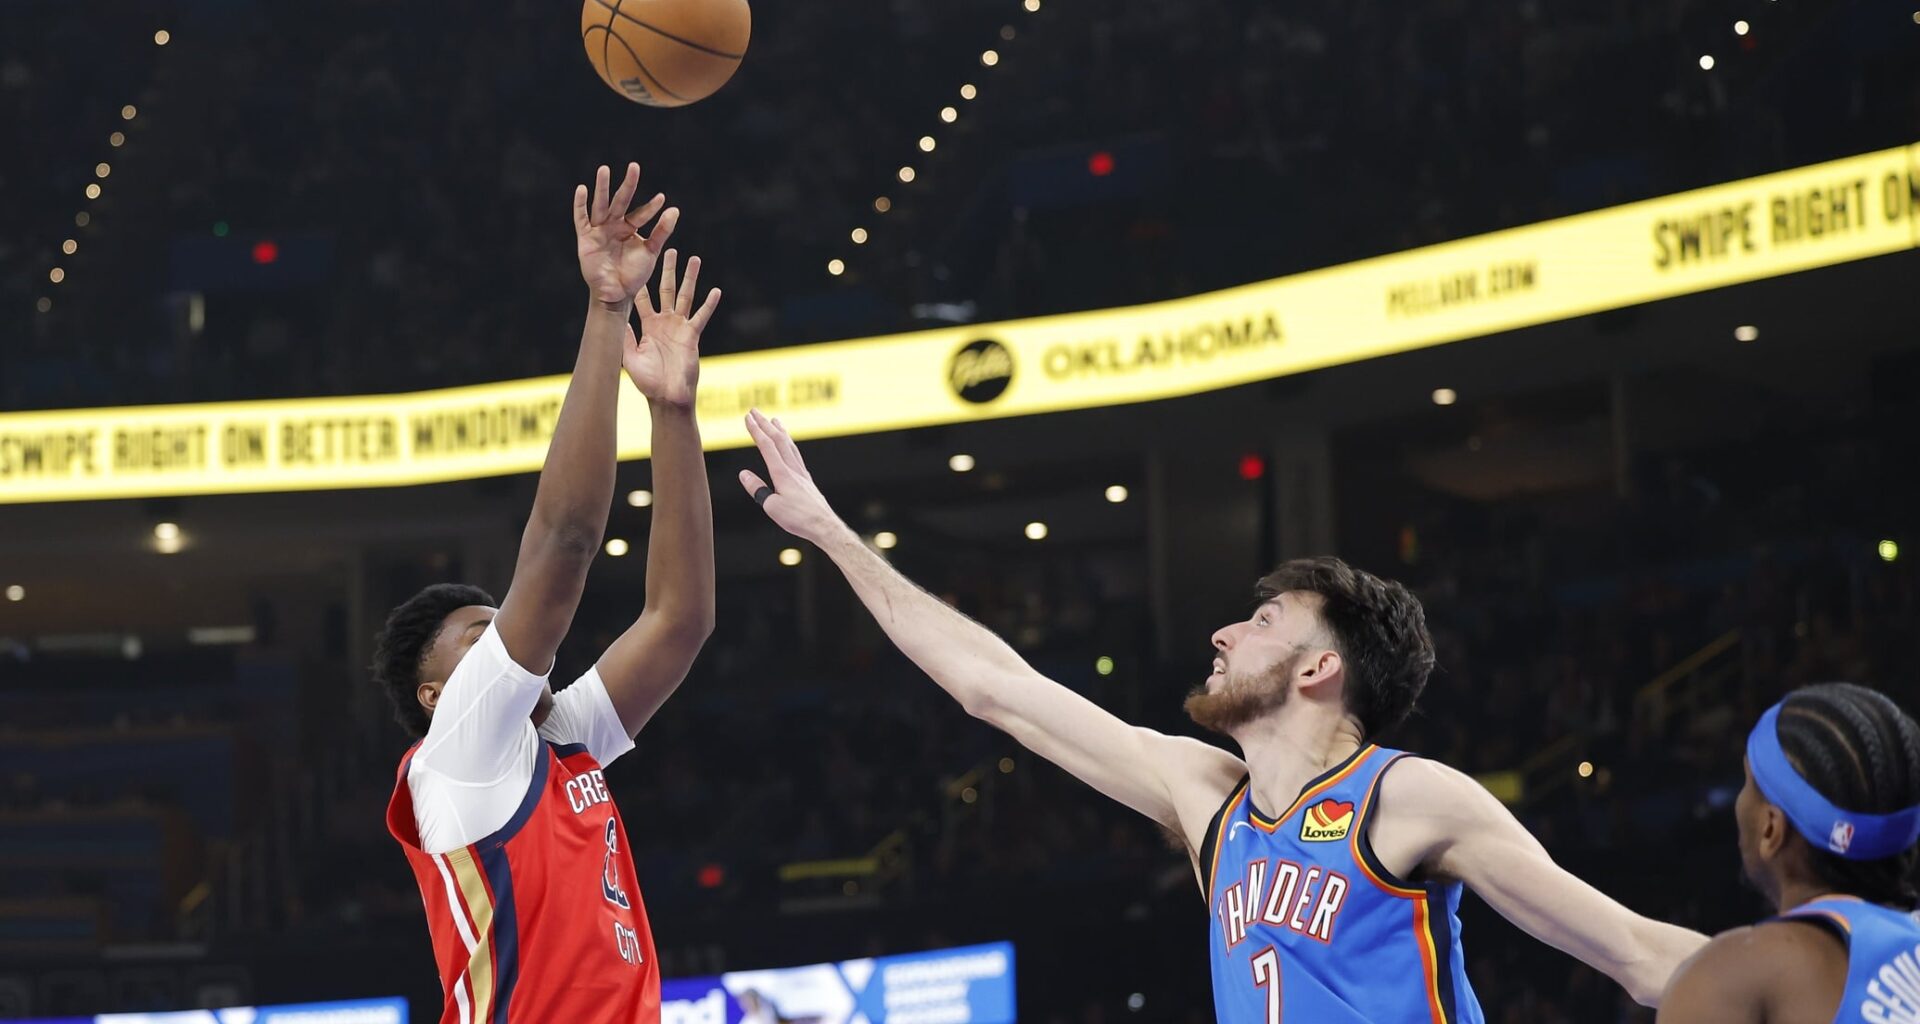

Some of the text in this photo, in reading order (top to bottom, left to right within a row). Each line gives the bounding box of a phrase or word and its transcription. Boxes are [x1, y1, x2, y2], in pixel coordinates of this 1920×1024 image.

[1654, 159, 1920, 269] SWIPE RIGHT ON
[1043, 315, 1282, 379] OKLAHOMA
[0, 432, 97, 476] SWIPE
[113, 427, 205, 470] RIGHT
[222, 426, 266, 465] ON
[280, 418, 398, 463] BETTER
[1250, 944, 1283, 1024] 7
